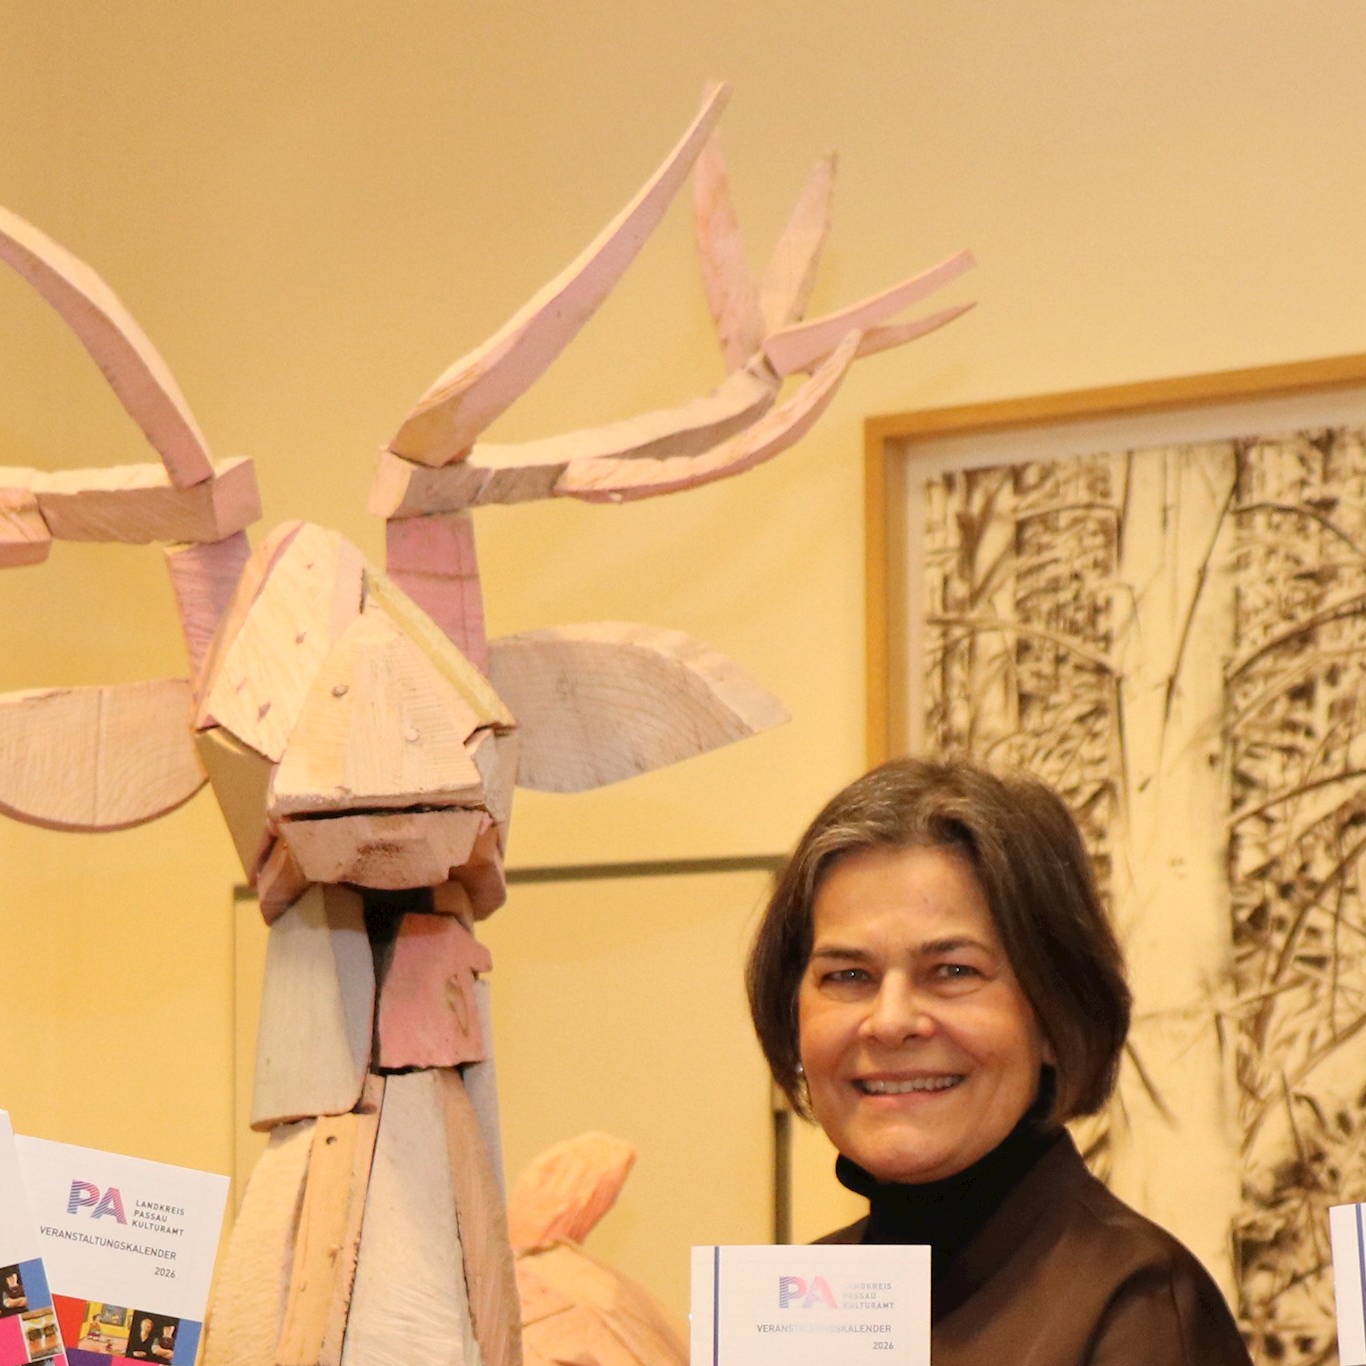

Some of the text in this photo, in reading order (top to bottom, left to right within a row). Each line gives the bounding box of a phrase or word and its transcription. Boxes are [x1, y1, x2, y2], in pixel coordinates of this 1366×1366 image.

[66, 1178, 128, 1225] PA
[135, 1199, 185, 1216] LANDKREIS
[133, 1209, 168, 1223] PASSAU
[131, 1219, 185, 1236] KULTURAMT
[39, 1225, 178, 1260] VERANSTALTUNGSKALENDER
[154, 1266, 176, 1279] 2026
[778, 1275, 839, 1309] PA
[843, 1282, 892, 1290] NDKREIS
[756, 1324, 892, 1334] VERANSTAGSKALENDER
[872, 1341, 895, 1350] 2026
